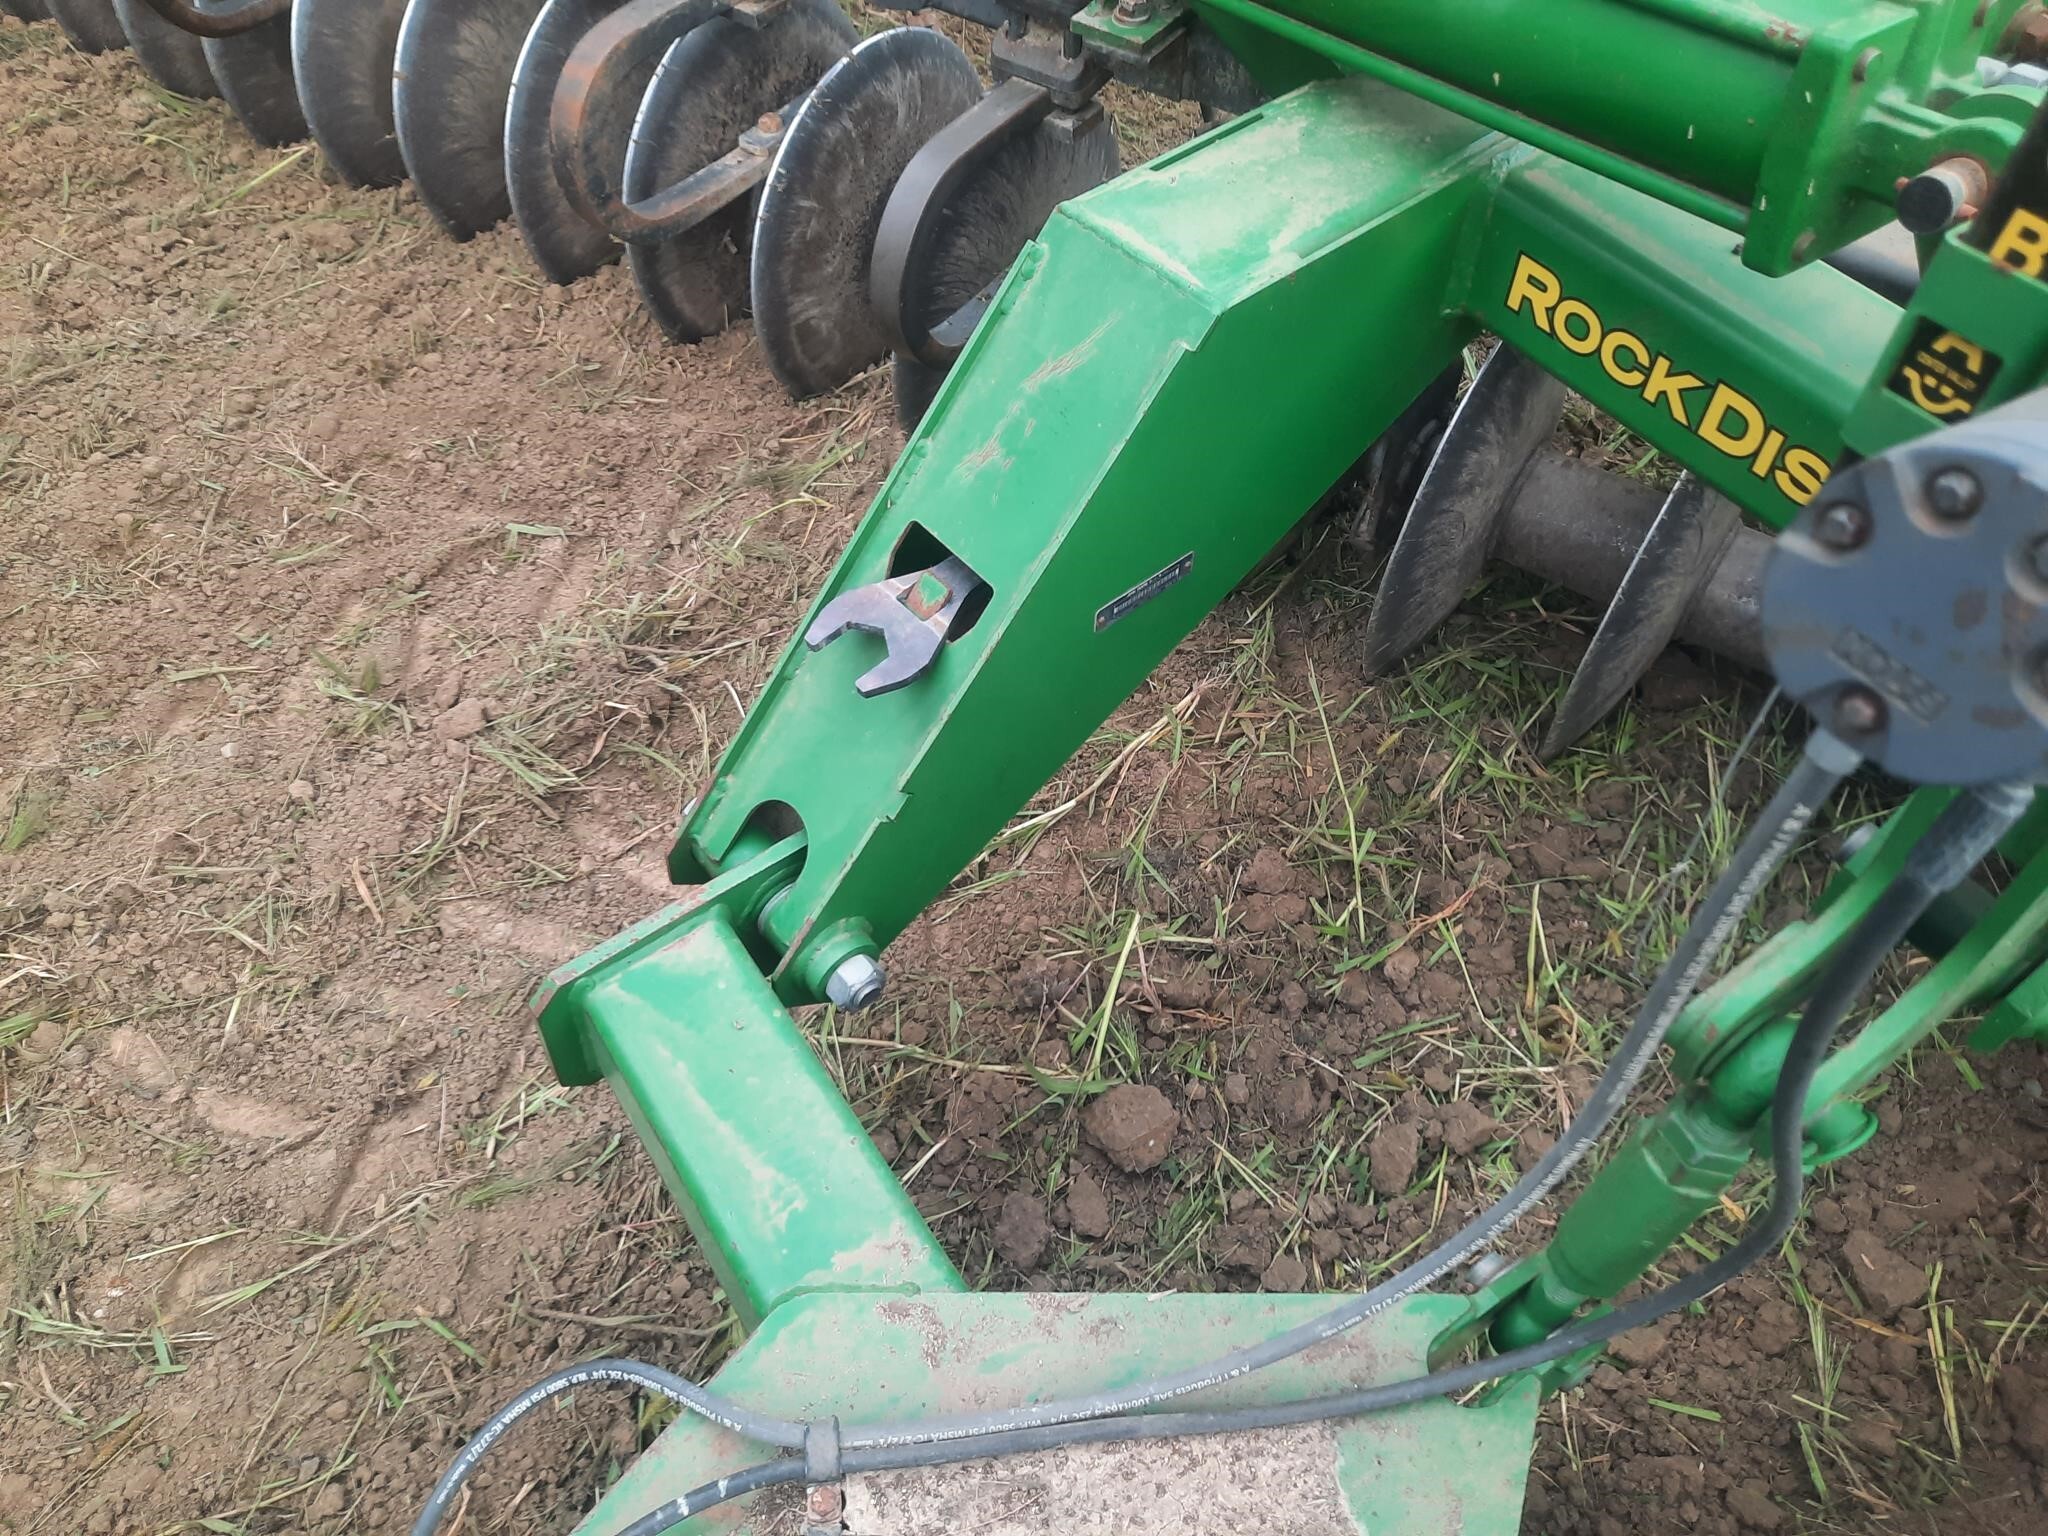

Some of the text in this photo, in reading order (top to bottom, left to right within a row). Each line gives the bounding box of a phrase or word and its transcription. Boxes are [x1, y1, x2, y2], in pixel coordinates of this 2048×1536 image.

[1230, 1369, 1239, 1377] &
[1241, 1364, 1250, 1373] A
[1175, 1376, 1222, 1395] Products
[530, 1388, 547, 1403] PSI
[503, 1400, 532, 1424] MSHA
[679, 1395, 717, 1420] Products
[723, 1419, 732, 1427] &
[734, 1422, 743, 1431] A
[931, 1428, 967, 1442] MSHA
